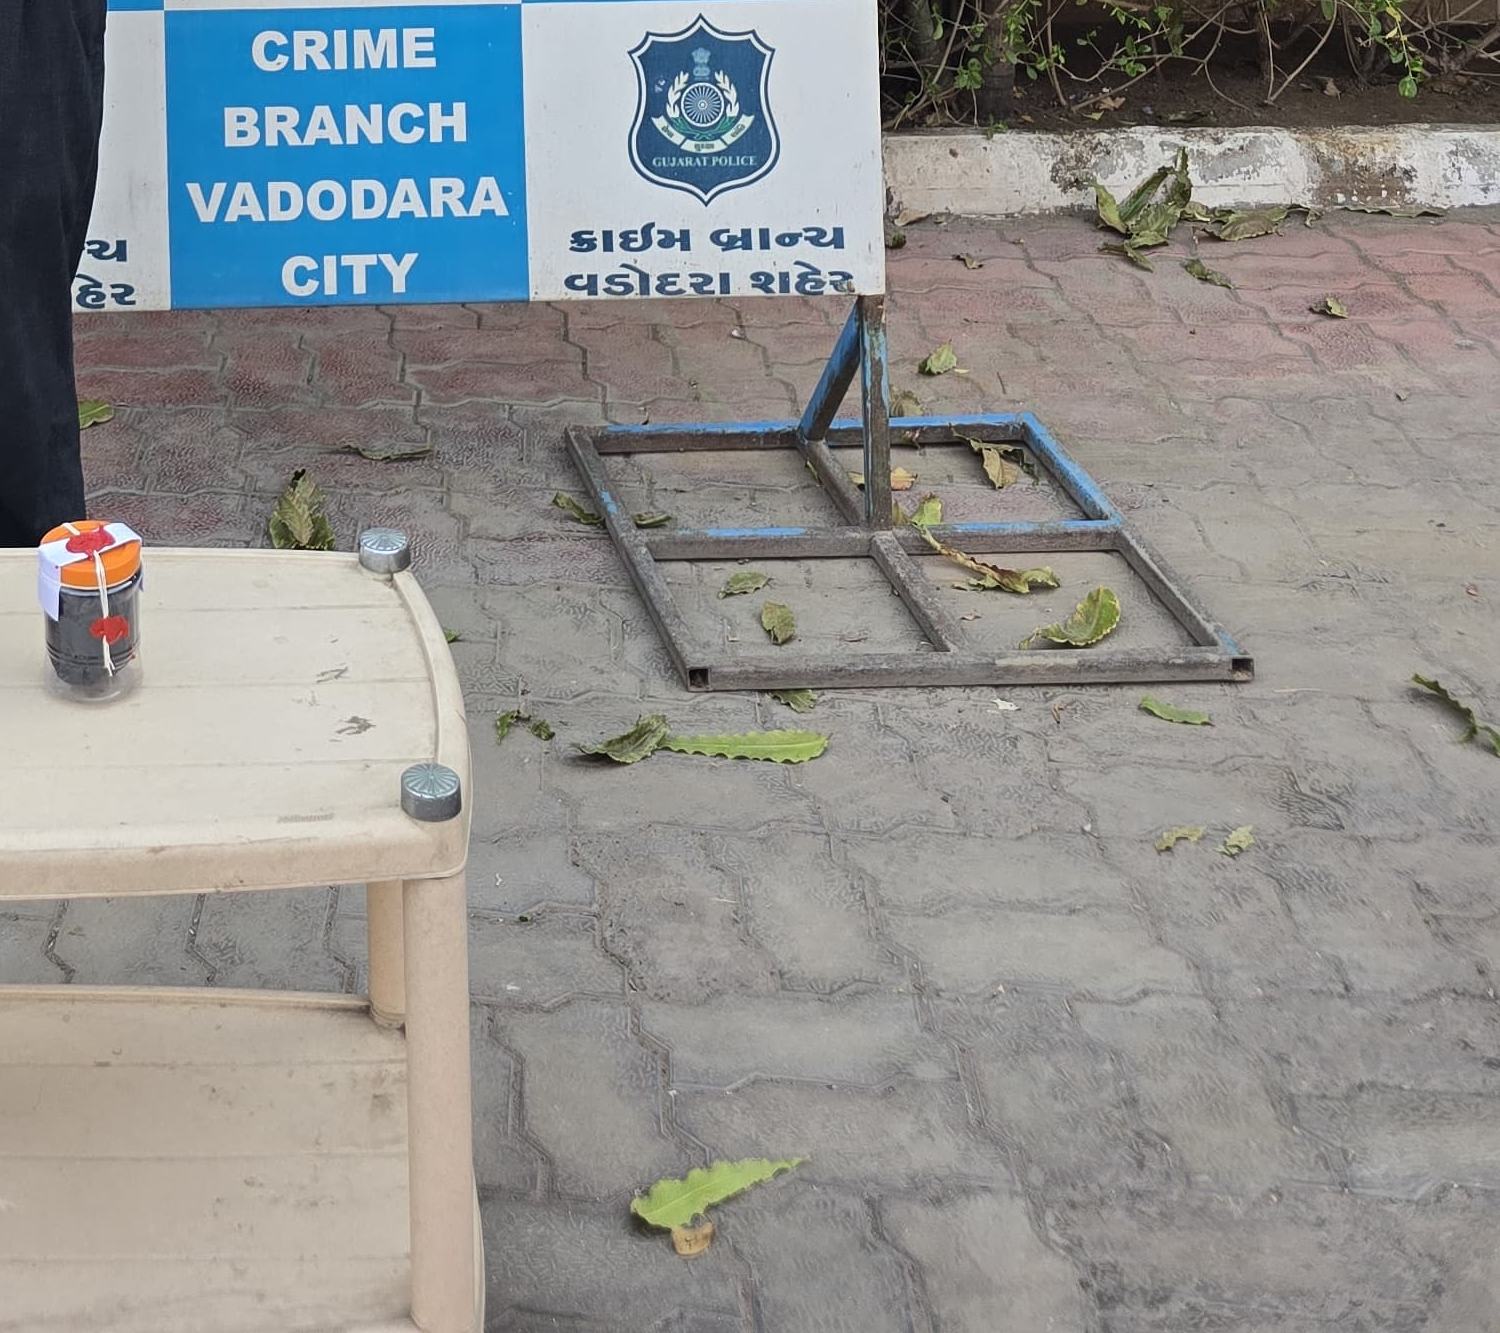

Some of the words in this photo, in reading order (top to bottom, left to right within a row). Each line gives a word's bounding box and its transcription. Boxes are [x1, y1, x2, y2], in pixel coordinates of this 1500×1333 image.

[251, 27, 437, 72] CRIME
[223, 102, 467, 147] BRANCH
[652, 156, 709, 168] GUJARAT
[711, 155, 759, 167] POLICE
[186, 176, 509, 223] VADODARA
[568, 221, 692, 253] ક્રાઈમ
[709, 226, 845, 253] બ્રાન્ચ
[76, 273, 136, 309] હેર
[281, 252, 418, 296] CITY
[563, 263, 731, 297] વડોદરા
[749, 260, 854, 295] શહેર
